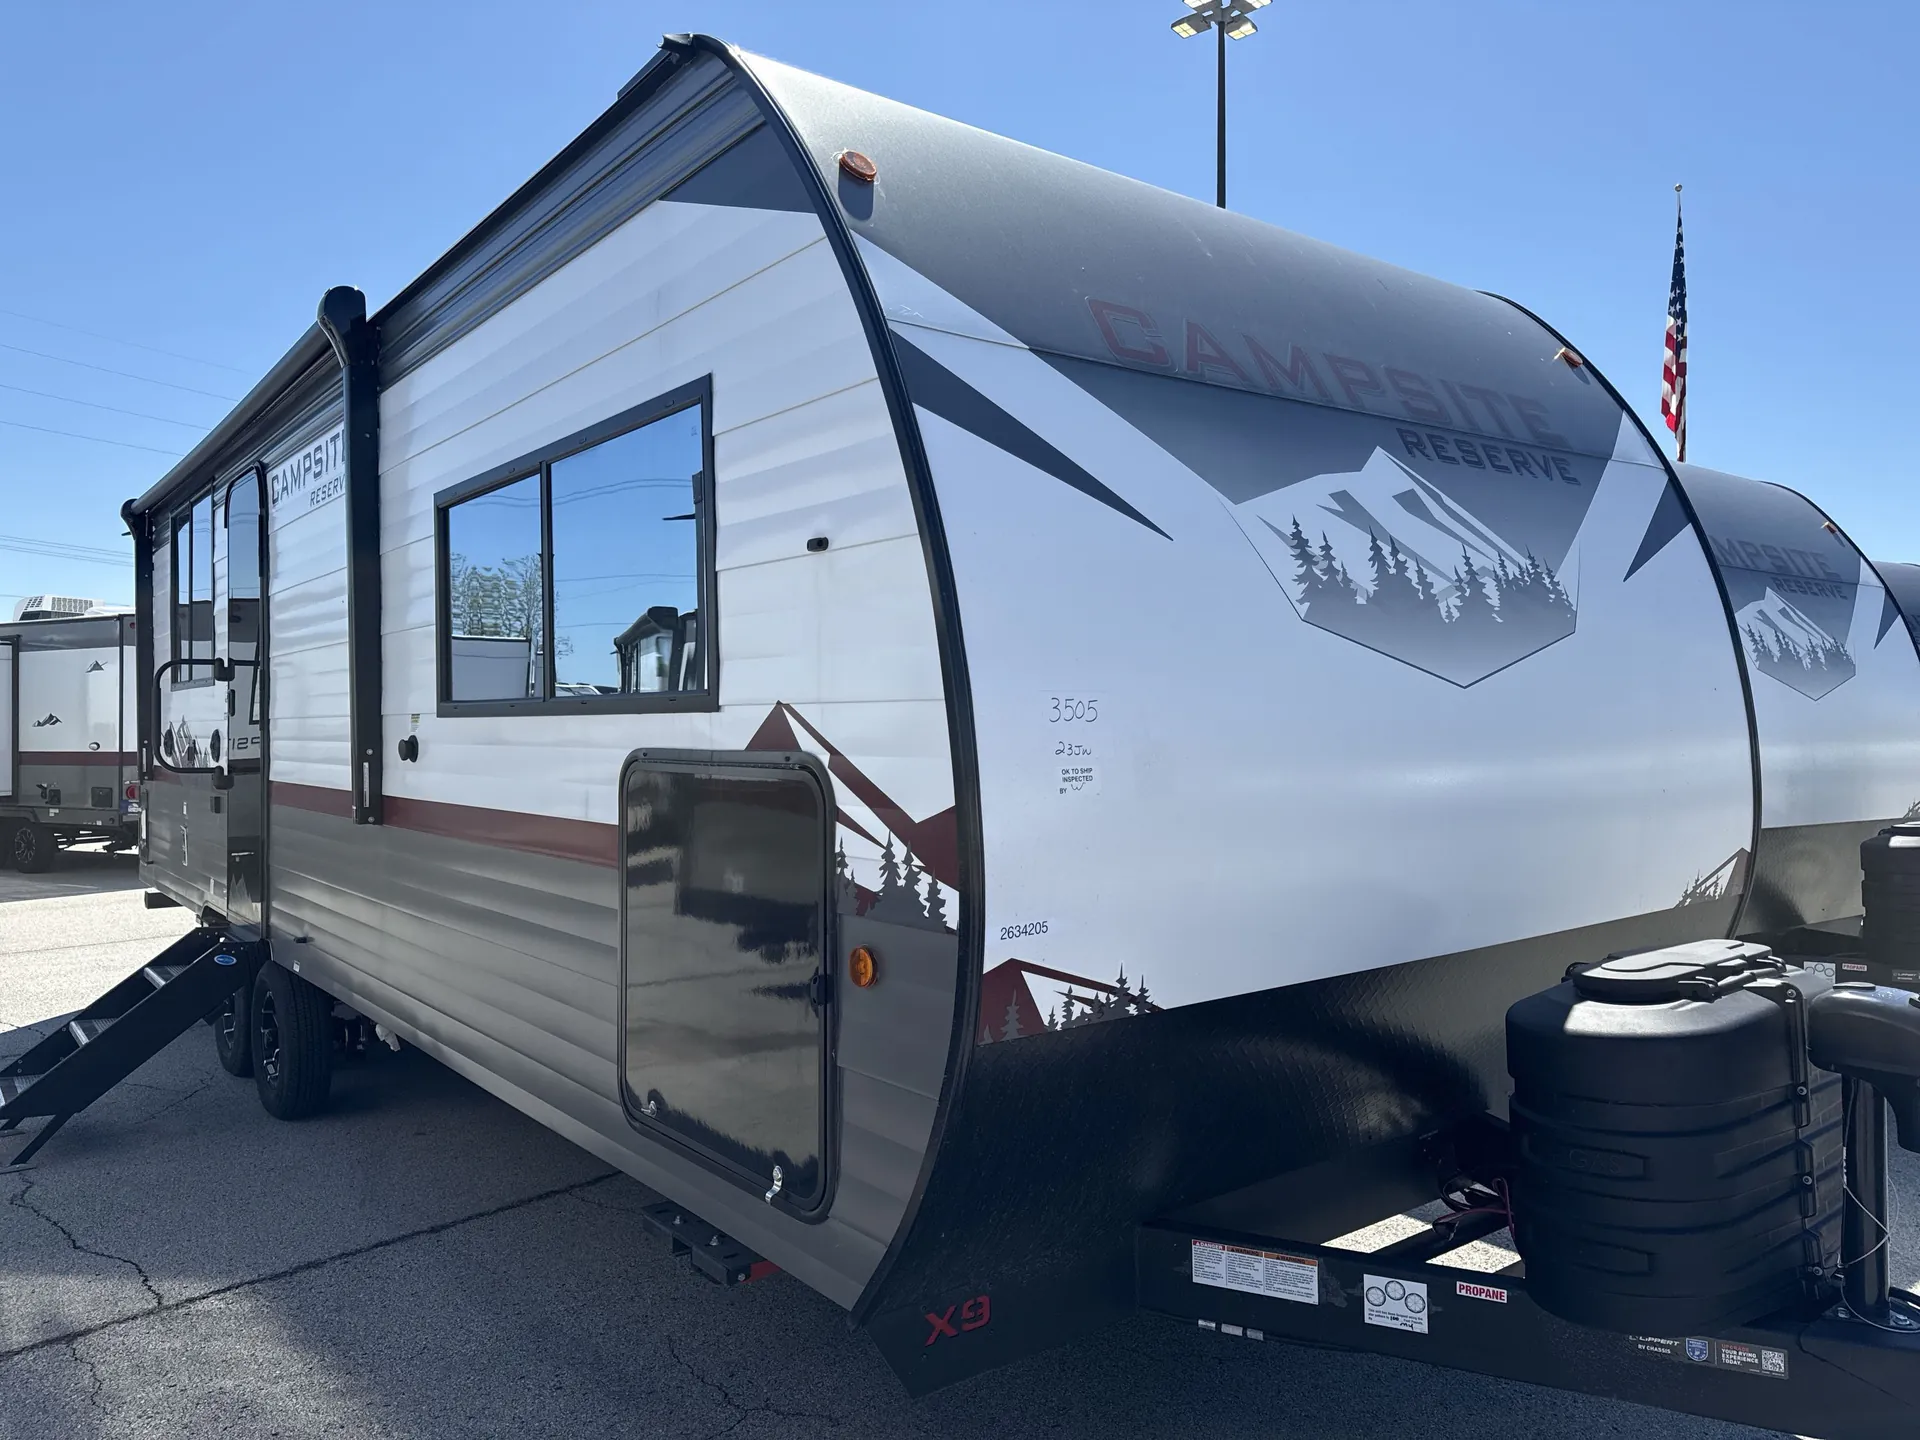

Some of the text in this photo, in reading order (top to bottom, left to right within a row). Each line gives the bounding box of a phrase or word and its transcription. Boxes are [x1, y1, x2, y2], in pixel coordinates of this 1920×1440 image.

[1086, 297, 1573, 450] CAMPSITE
[1396, 427, 1581, 496] RESERVE
[310, 473, 346, 507] RESERV
[1708, 535, 1843, 582] MPSITE
[1770, 577, 1848, 600] RESERVE
[1049, 697, 1098, 722] 3505
[1062, 775, 1093, 783] INSPECTED
[1000, 920, 1049, 940] 2634205
[1458, 1283, 1506, 1301] PROPANE
[924, 1295, 991, 1348] X9
[1646, 1345, 1671, 1354] CHASSIS
[1721, 1353, 1759, 1364] EXPERIENCE
